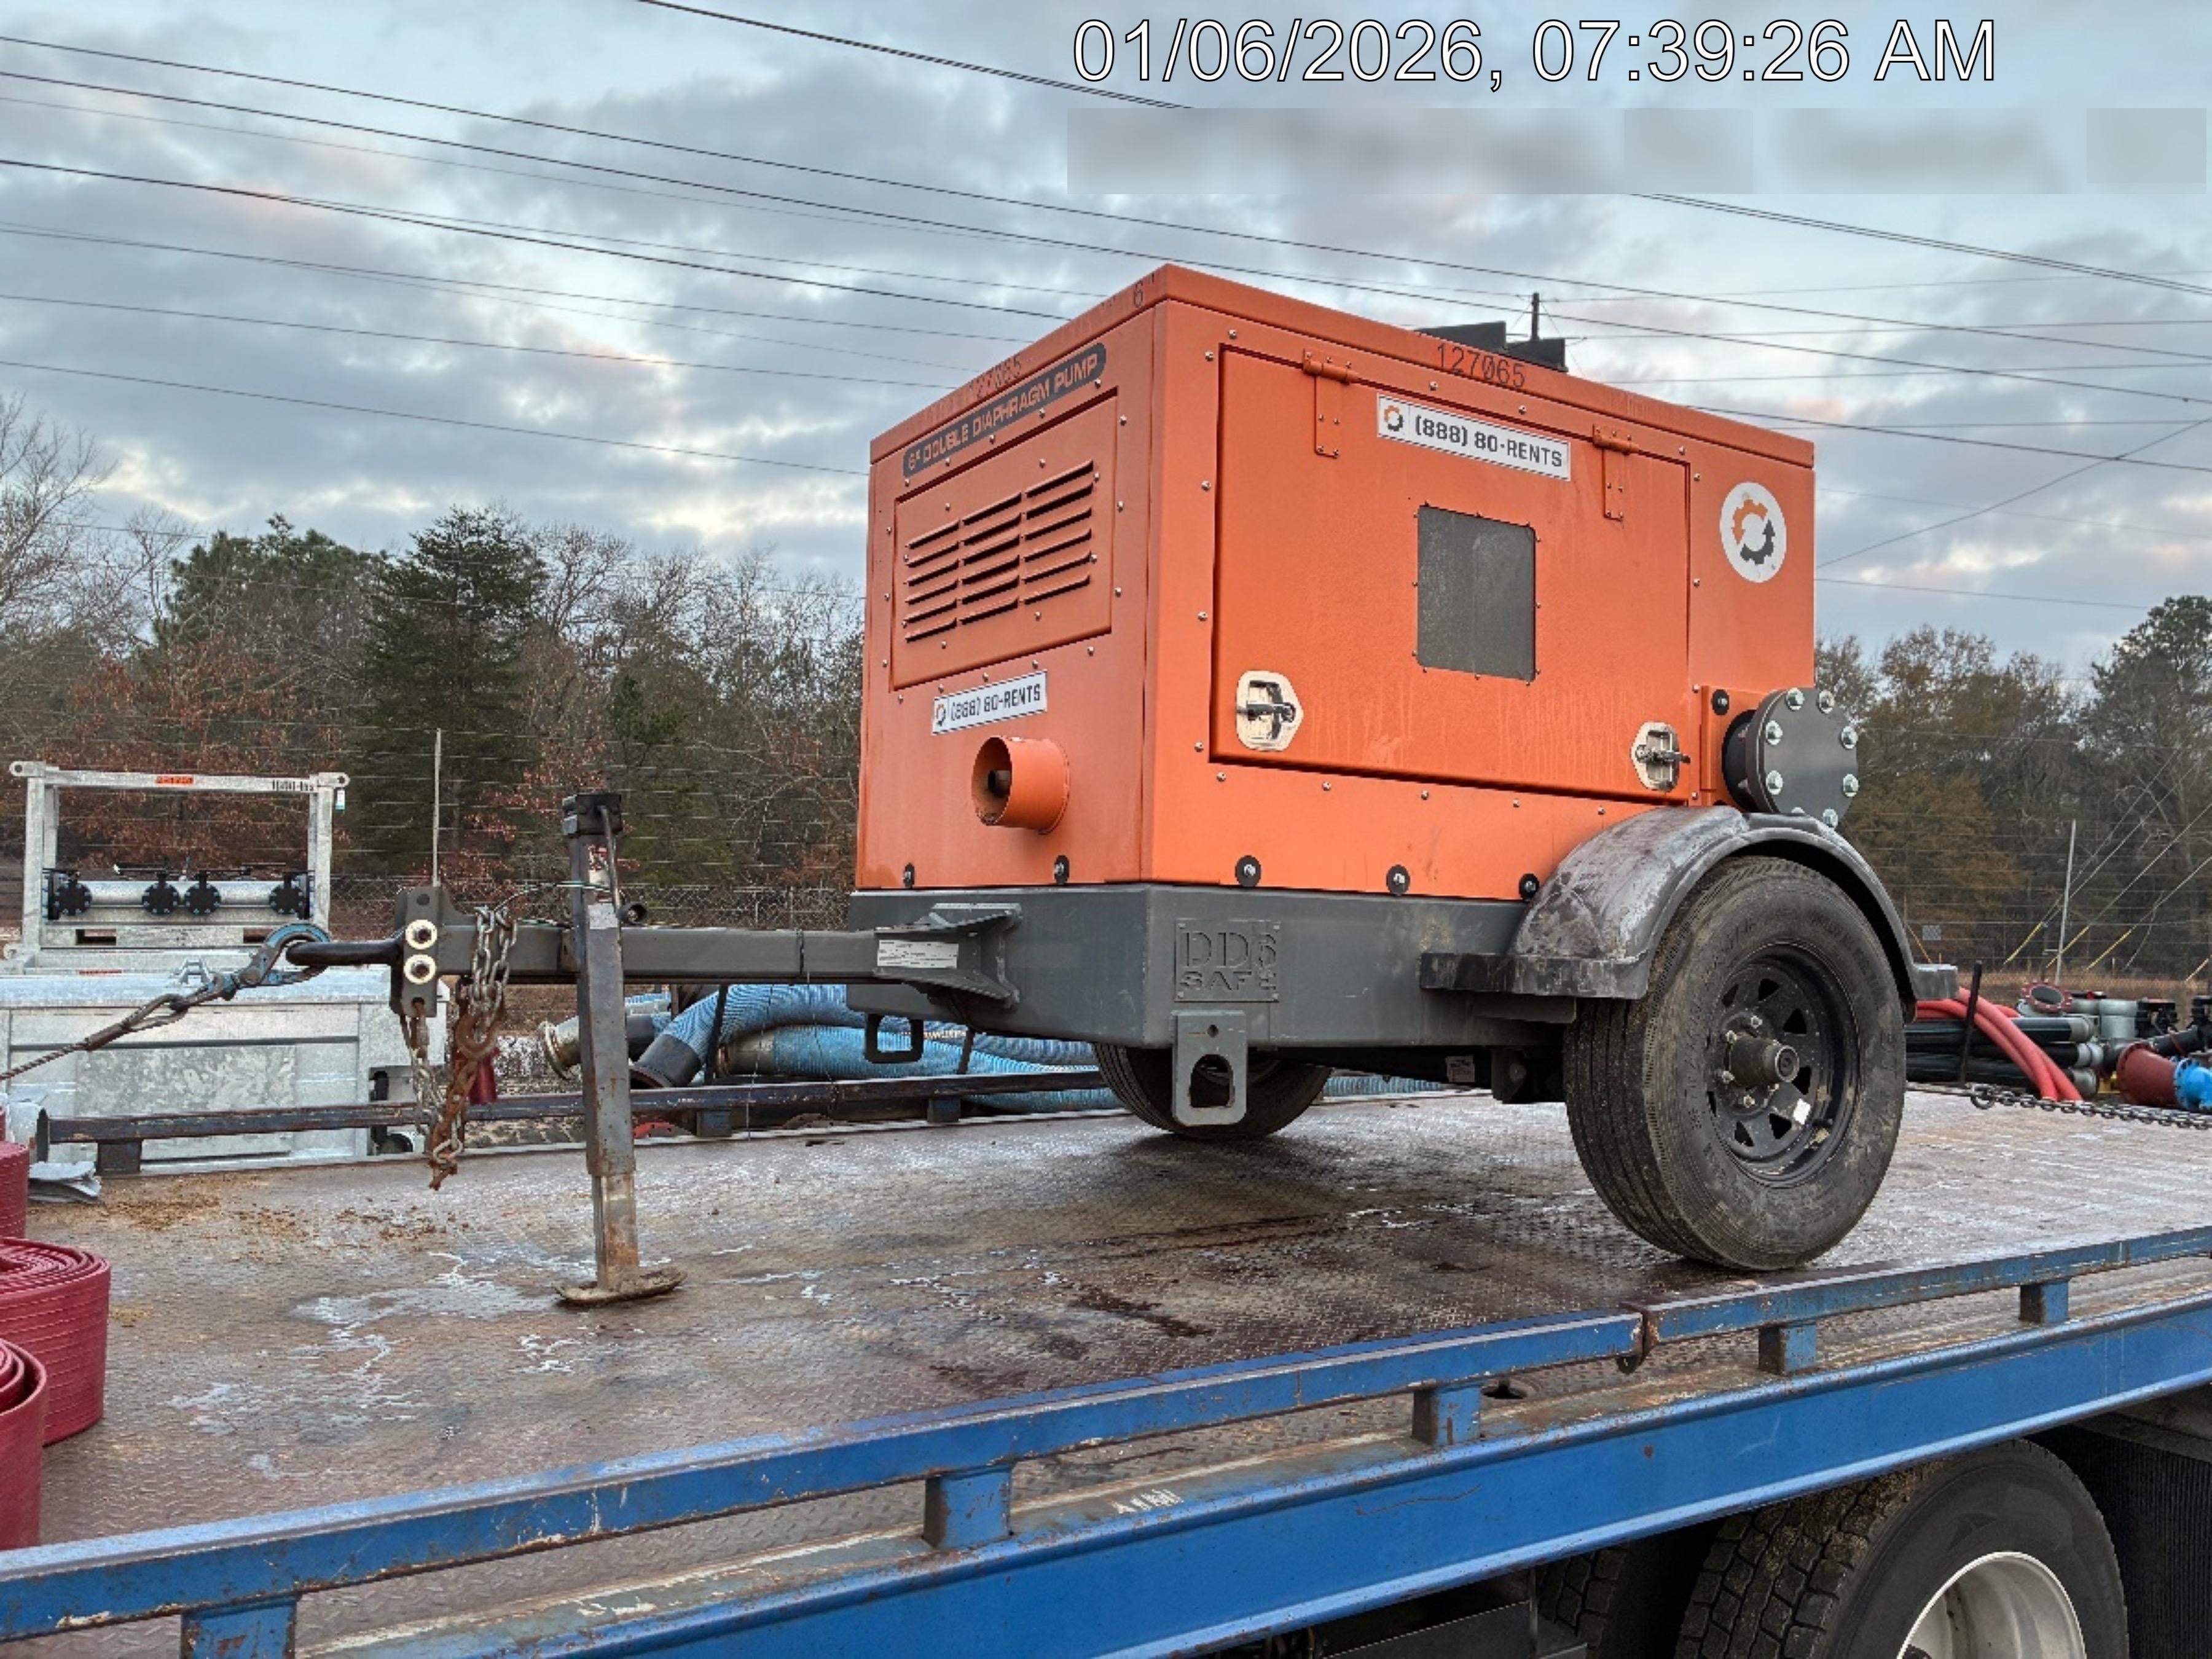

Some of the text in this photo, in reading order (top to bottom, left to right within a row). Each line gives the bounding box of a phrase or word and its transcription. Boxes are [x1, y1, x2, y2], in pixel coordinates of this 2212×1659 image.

[1437, 342, 1526, 388] 127065
[923, 423, 969, 463] DOUBLE
[973, 377, 1050, 437] DIAPHRAGM
[1054, 353, 1098, 394] PUMP
[1415, 415, 1563, 468] (888) 80-RENTS
